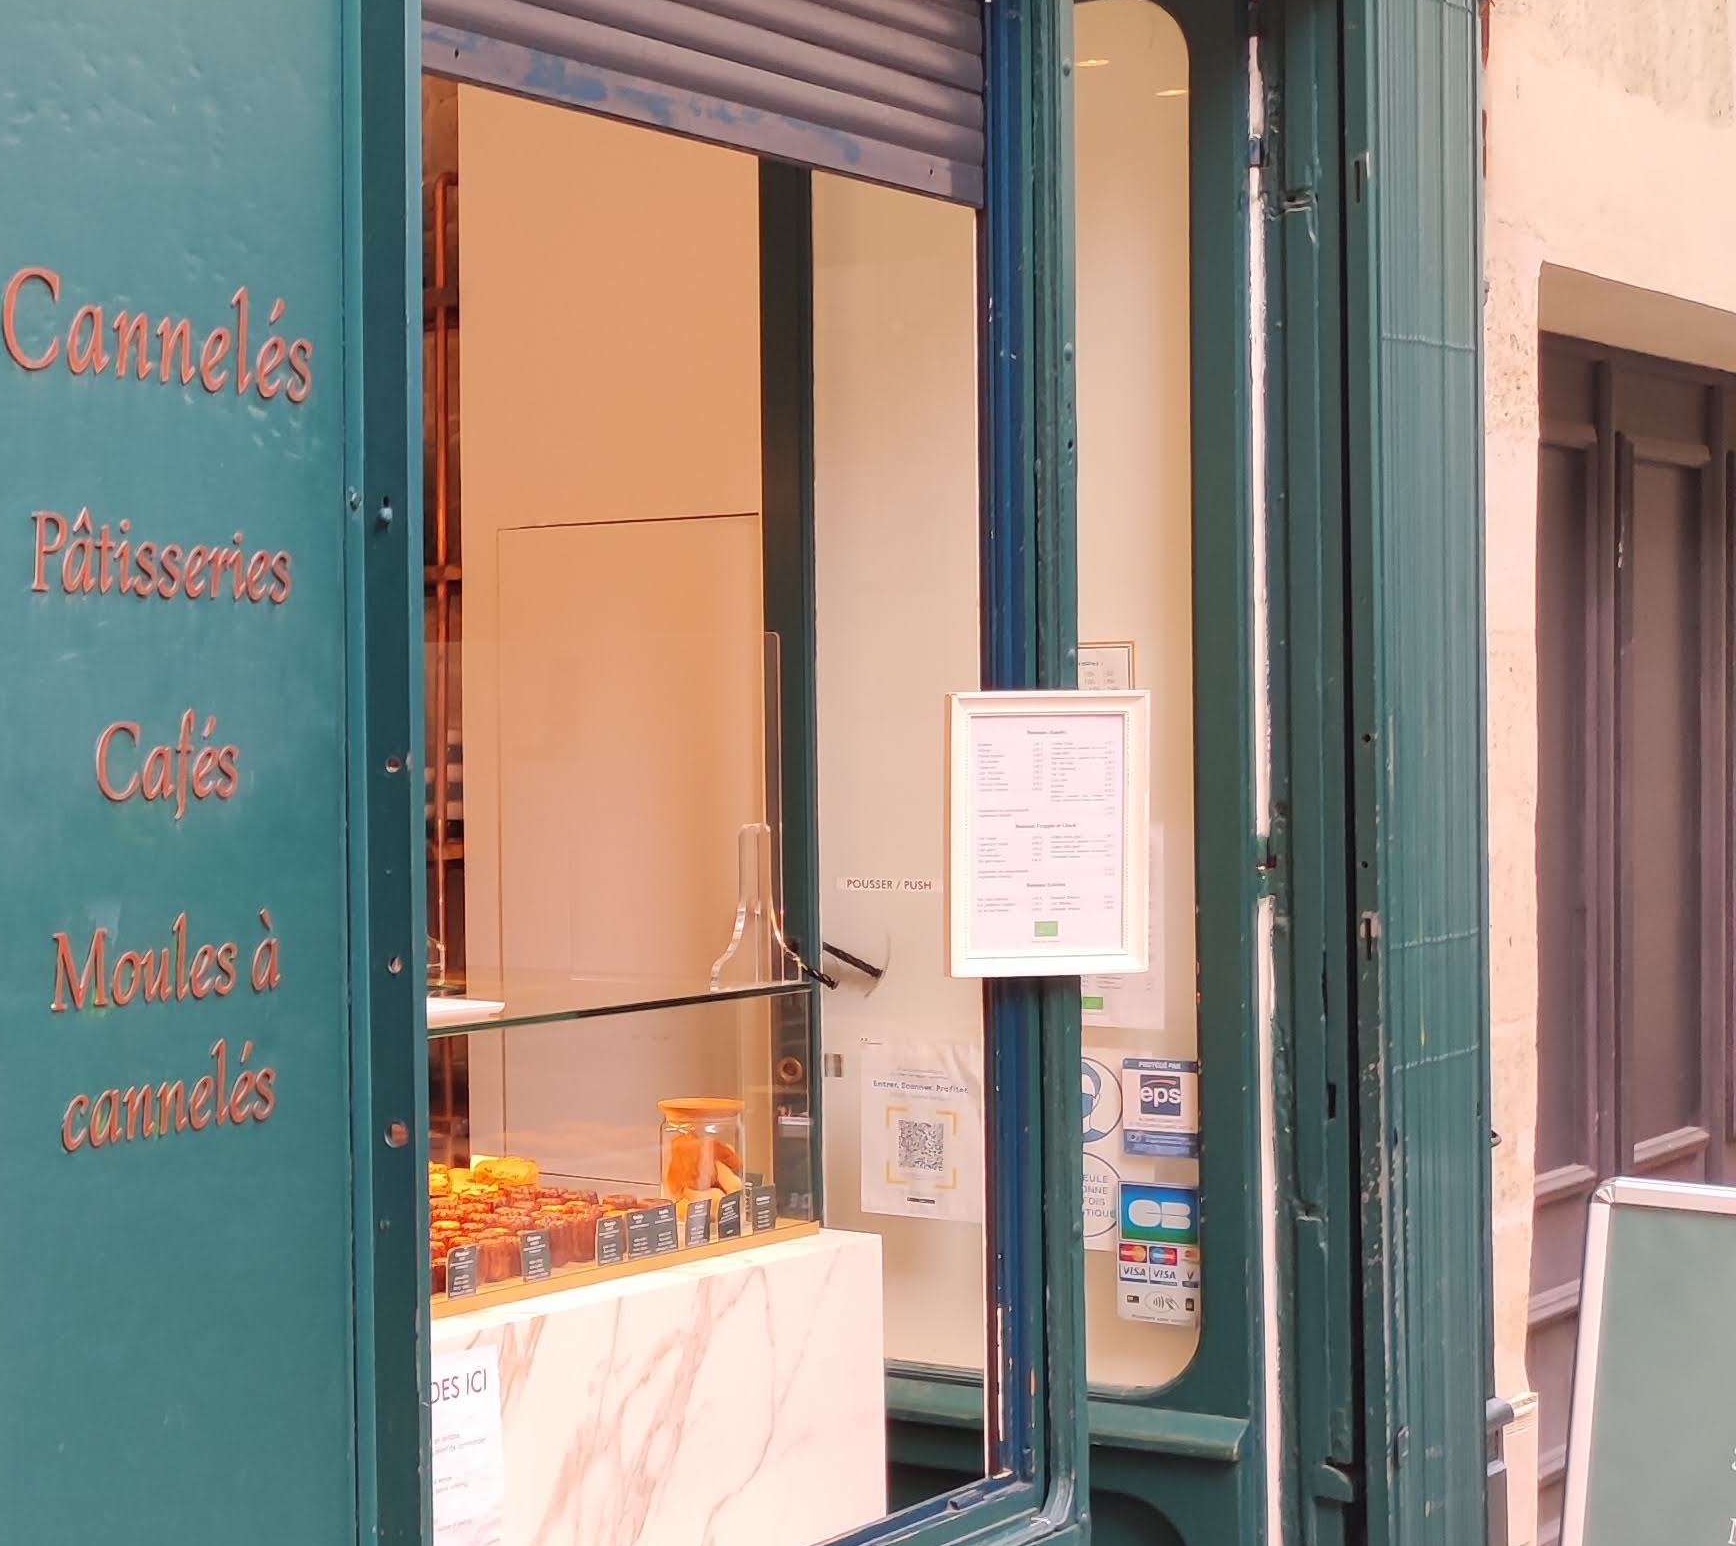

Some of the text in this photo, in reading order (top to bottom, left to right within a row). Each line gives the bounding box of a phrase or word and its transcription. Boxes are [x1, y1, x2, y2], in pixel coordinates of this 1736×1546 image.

[2, 266, 313, 403] Cannelés
[30, 506, 293, 605] Pâtisseries
[96, 709, 239, 820] Cafés
[846, 879, 893, 890] POUSSER
[904, 880, 932, 891] PUSH
[51, 908, 281, 1013] Moules à
[62, 1038, 276, 1153] cannelés
[1140, 1086, 1182, 1108] eps
[1123, 1266, 1146, 1277] VISA
[1153, 1269, 1177, 1280] VISA
[466, 1368, 487, 1396] ICI
